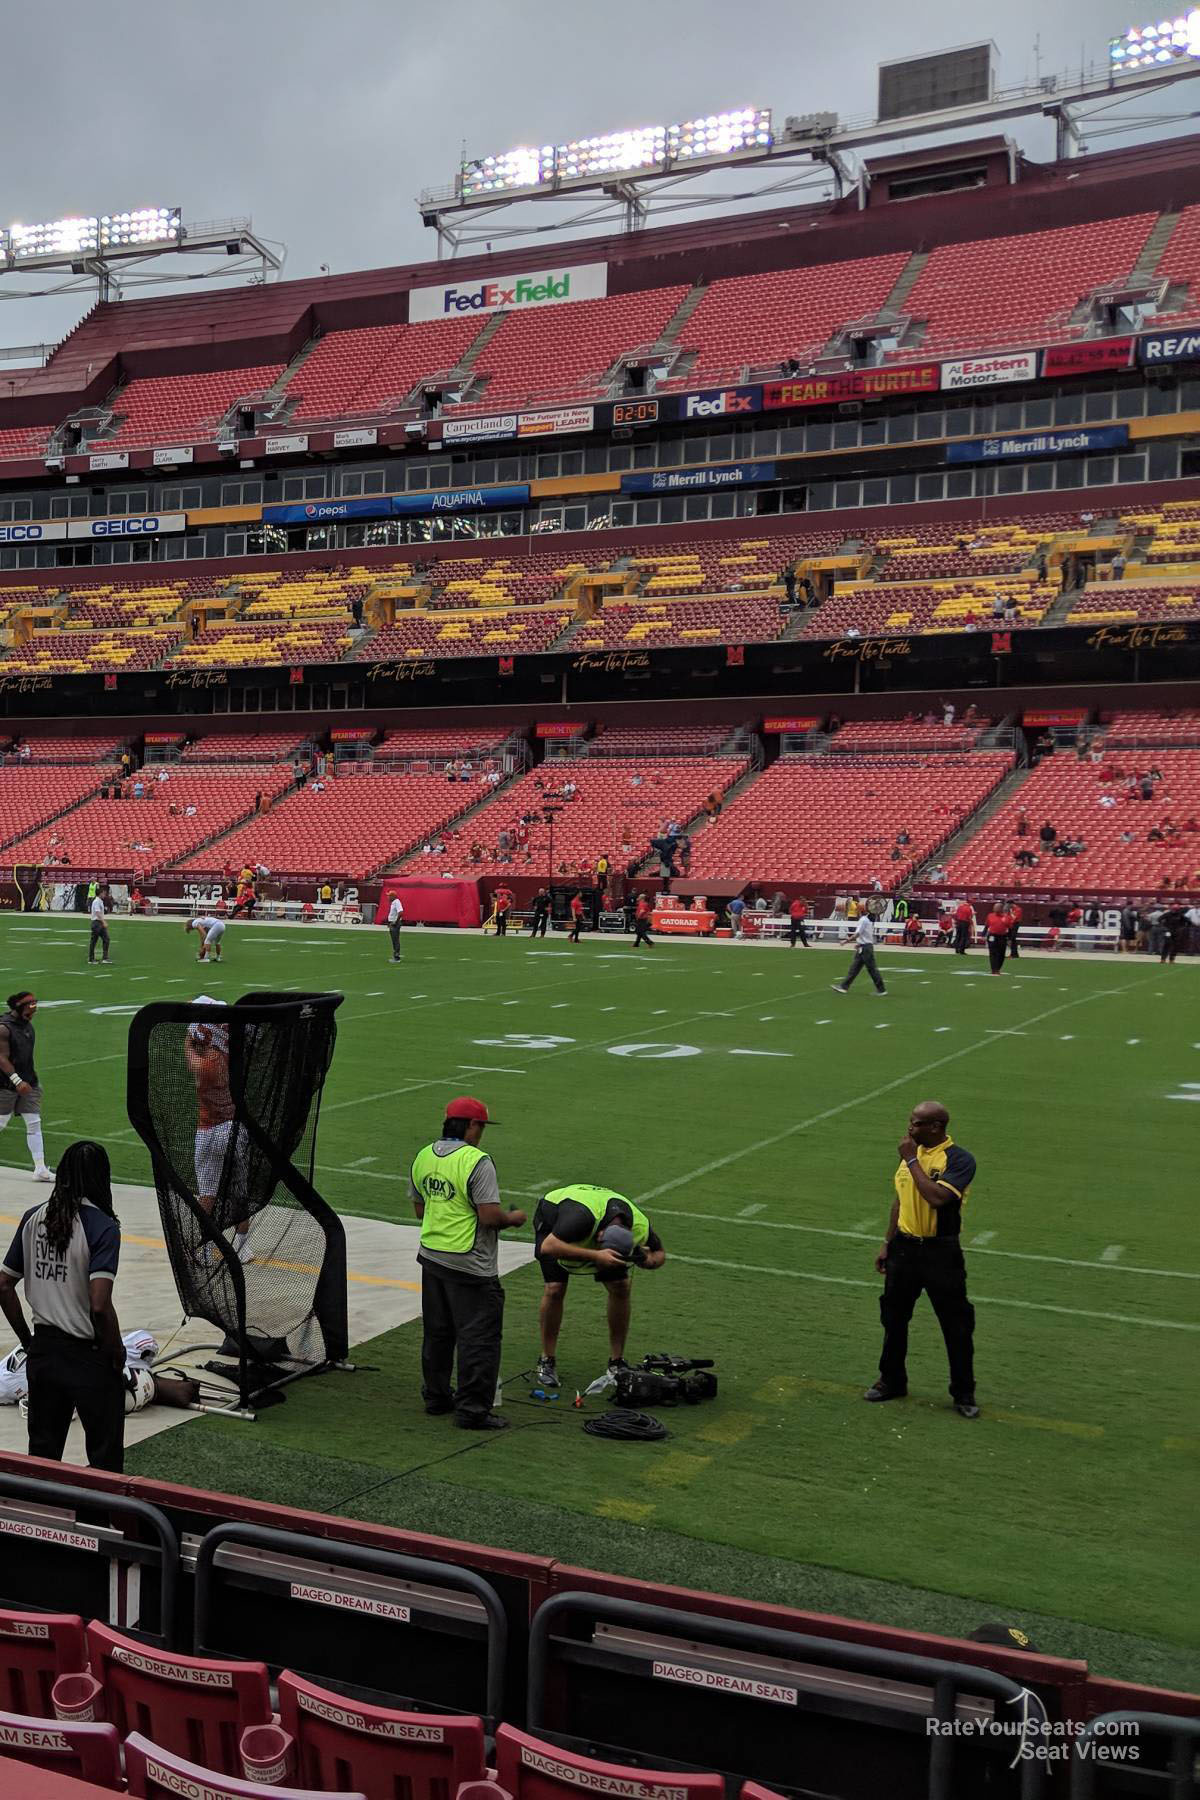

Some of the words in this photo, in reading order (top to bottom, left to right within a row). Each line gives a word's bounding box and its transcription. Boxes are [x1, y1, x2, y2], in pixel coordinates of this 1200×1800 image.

[444, 273, 570, 313] FedExField
[962, 357, 1029, 375] Eastern
[687, 391, 752, 417] FedEx
[446, 416, 503, 434] Carpetland
[537, 412, 562, 421] Future
[556, 417, 589, 427] LEARN
[519, 422, 553, 433] Support
[267, 445, 290, 453] HARVEY
[1001, 438, 1046, 455] Merrill
[1049, 434, 1089, 453] Lynch
[668, 471, 707, 487] Merrill
[709, 469, 743, 484] Lynch
[432, 491, 485, 509] AQUAFINA
[318, 505, 347, 517] pepsi
[92, 517, 159, 536] GEICO
[660, 918, 699, 926] GATORADE
[35, 1263, 68, 1283] STAFF
[0, 1520, 34, 1536] DIAGEO
[35, 1526, 68, 1544] DREAM
[70, 1535, 97, 1550] SEATS
[292, 1586, 332, 1602] DIAGEO
[334, 1593, 373, 1613] DREAM
[376, 1602, 407, 1619] SEATS
[144, 1660, 188, 1680] DREAM
[192, 1671, 230, 1685] SEATS
[653, 1663, 704, 1684] DIAGEO
[706, 1674, 752, 1694] DREAM
[756, 1684, 794, 1702] SEATS
[298, 1694, 343, 1723] DIAGEO
[399, 1725, 441, 1741] SEATS
[148, 1763, 200, 1799] DIAGEO
[524, 1750, 576, 1781] DIAGEO
[579, 1770, 635, 1798] DREAM
